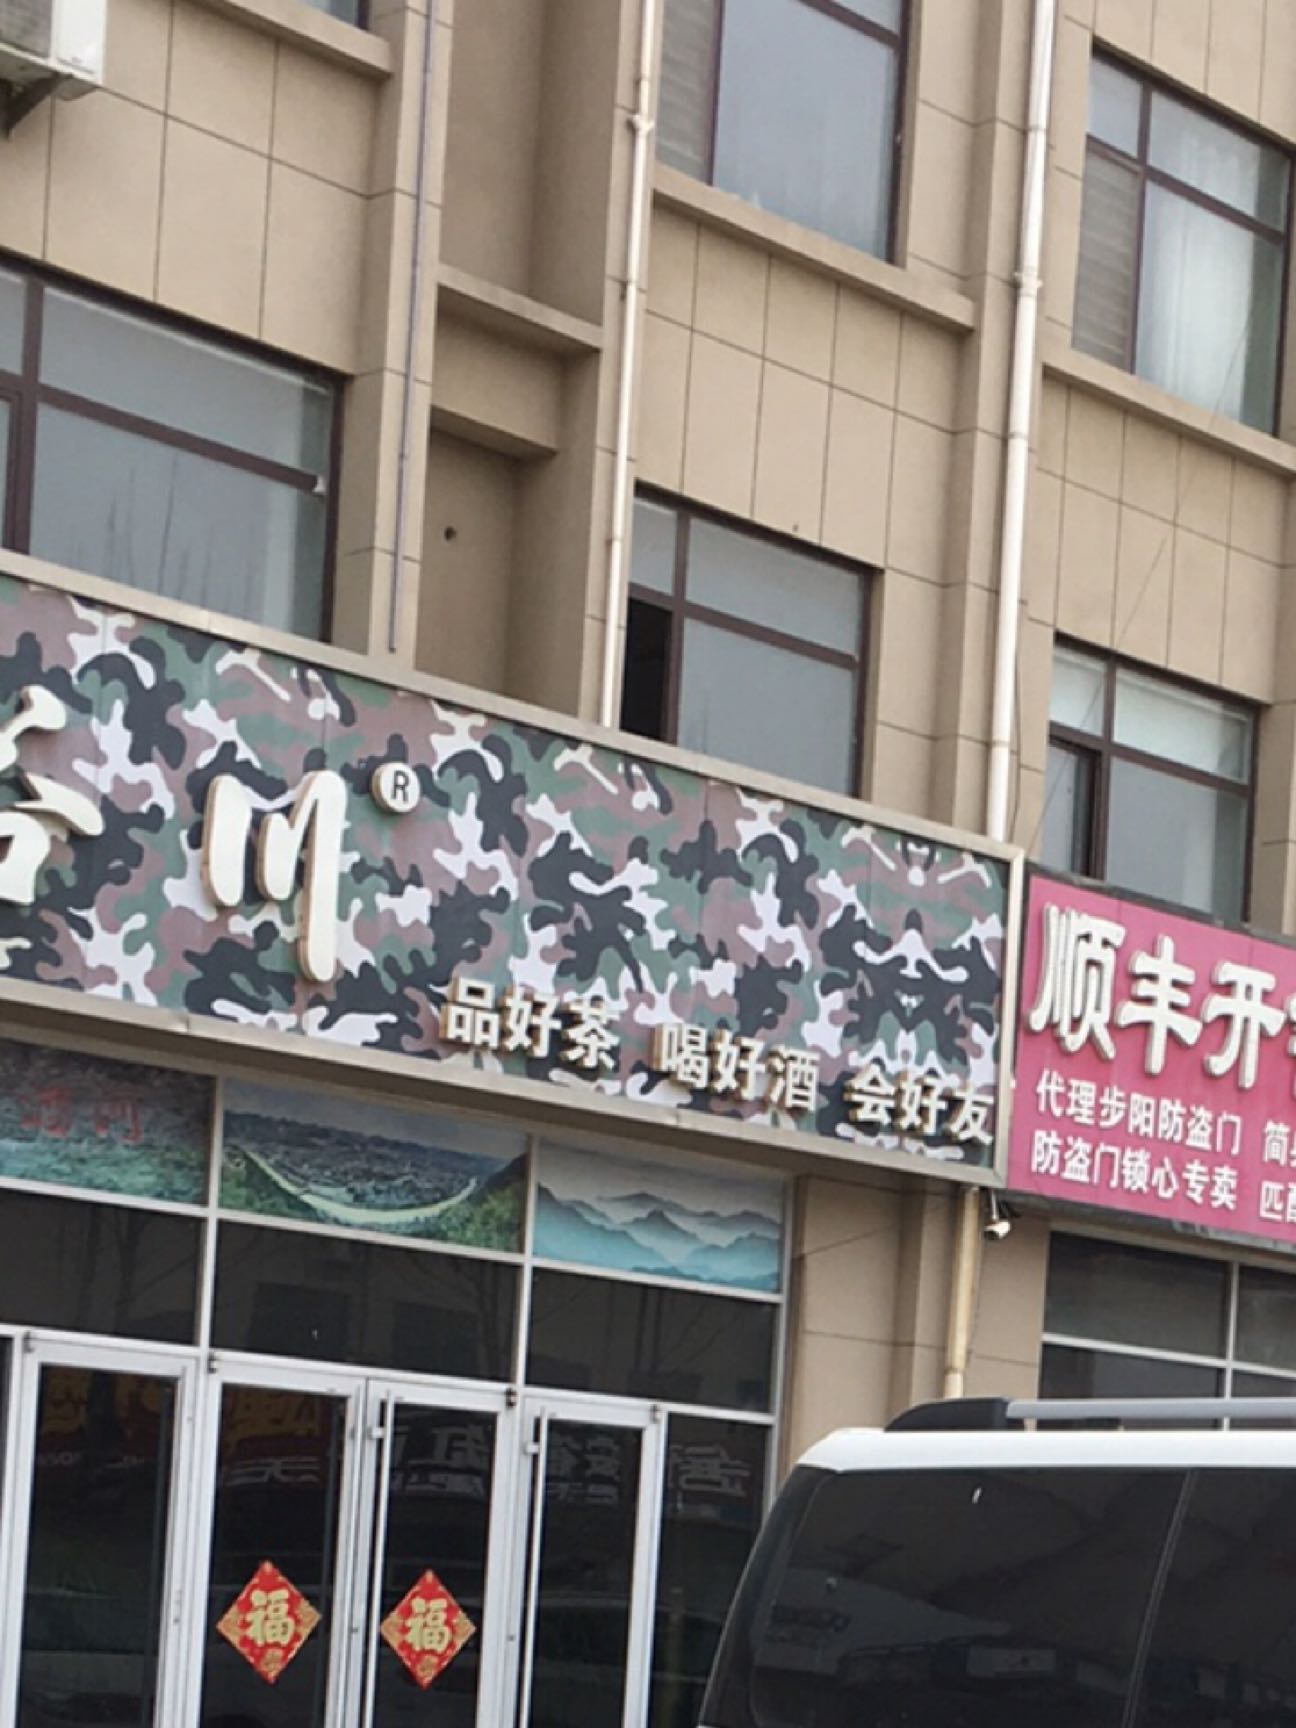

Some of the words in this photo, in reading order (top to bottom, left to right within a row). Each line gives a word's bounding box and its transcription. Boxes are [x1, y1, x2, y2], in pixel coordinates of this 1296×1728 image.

[440, 976, 620, 1070] 品好茶
[653, 1021, 821, 1112] 喝好酒
[843, 1063, 994, 1146] 会好友
[1035, 1068, 1242, 1156] 代理步阳防盗门
[1030, 1130, 1239, 1211] 防盗门锁心专卖
[246, 1589, 295, 1646] 福
[406, 1596, 452, 1653] 福
